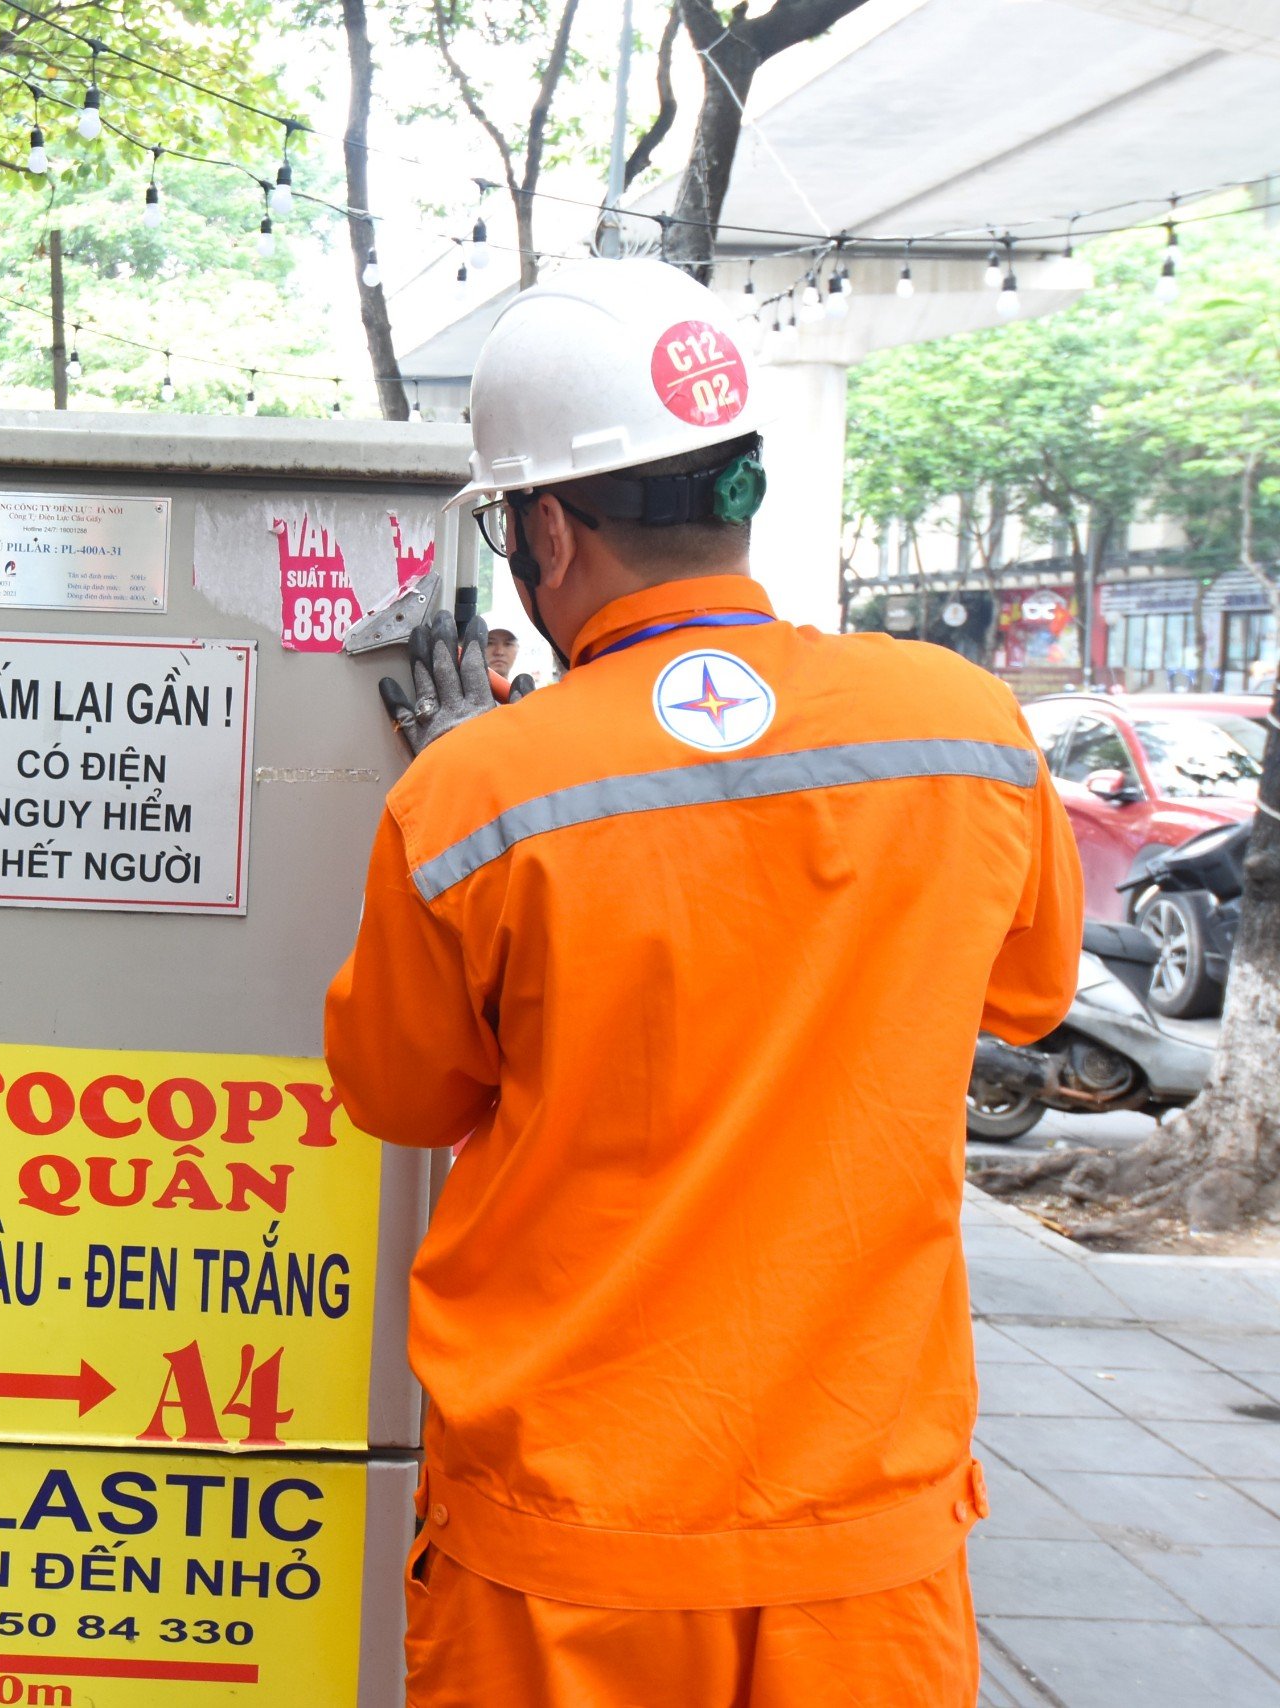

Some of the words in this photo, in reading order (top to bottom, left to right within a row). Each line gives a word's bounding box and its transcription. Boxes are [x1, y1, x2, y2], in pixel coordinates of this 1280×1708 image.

[666, 331, 725, 372] C12
[14, 503, 38, 512] CÔNG
[40, 504, 52, 512] TY
[7, 541, 51, 553] PILLAR
[61, 544, 122, 556] PL-400A-31
[287, 565, 326, 588] SUẤT
[54, 680, 113, 733] LẠI
[127, 666, 210, 727] GẦN
[225, 686, 233, 727] !
[17, 743, 70, 779] CÓ
[81, 746, 167, 789] ĐIỆN
[104, 788, 192, 833] HIỂM
[84, 845, 201, 884] NGƯỜI
[18, 1144, 296, 1216] QUÂN
[84, 1243, 178, 1312] ĐEN
[193, 1220, 350, 1319] TRẮNG
[136, 1338, 294, 1447] A4
[31, 1540, 161, 1594] ĐẾN
[185, 1548, 321, 1602] NHỎ
[76, 1615, 140, 1642] 84
[159, 1618, 255, 1646] 330
